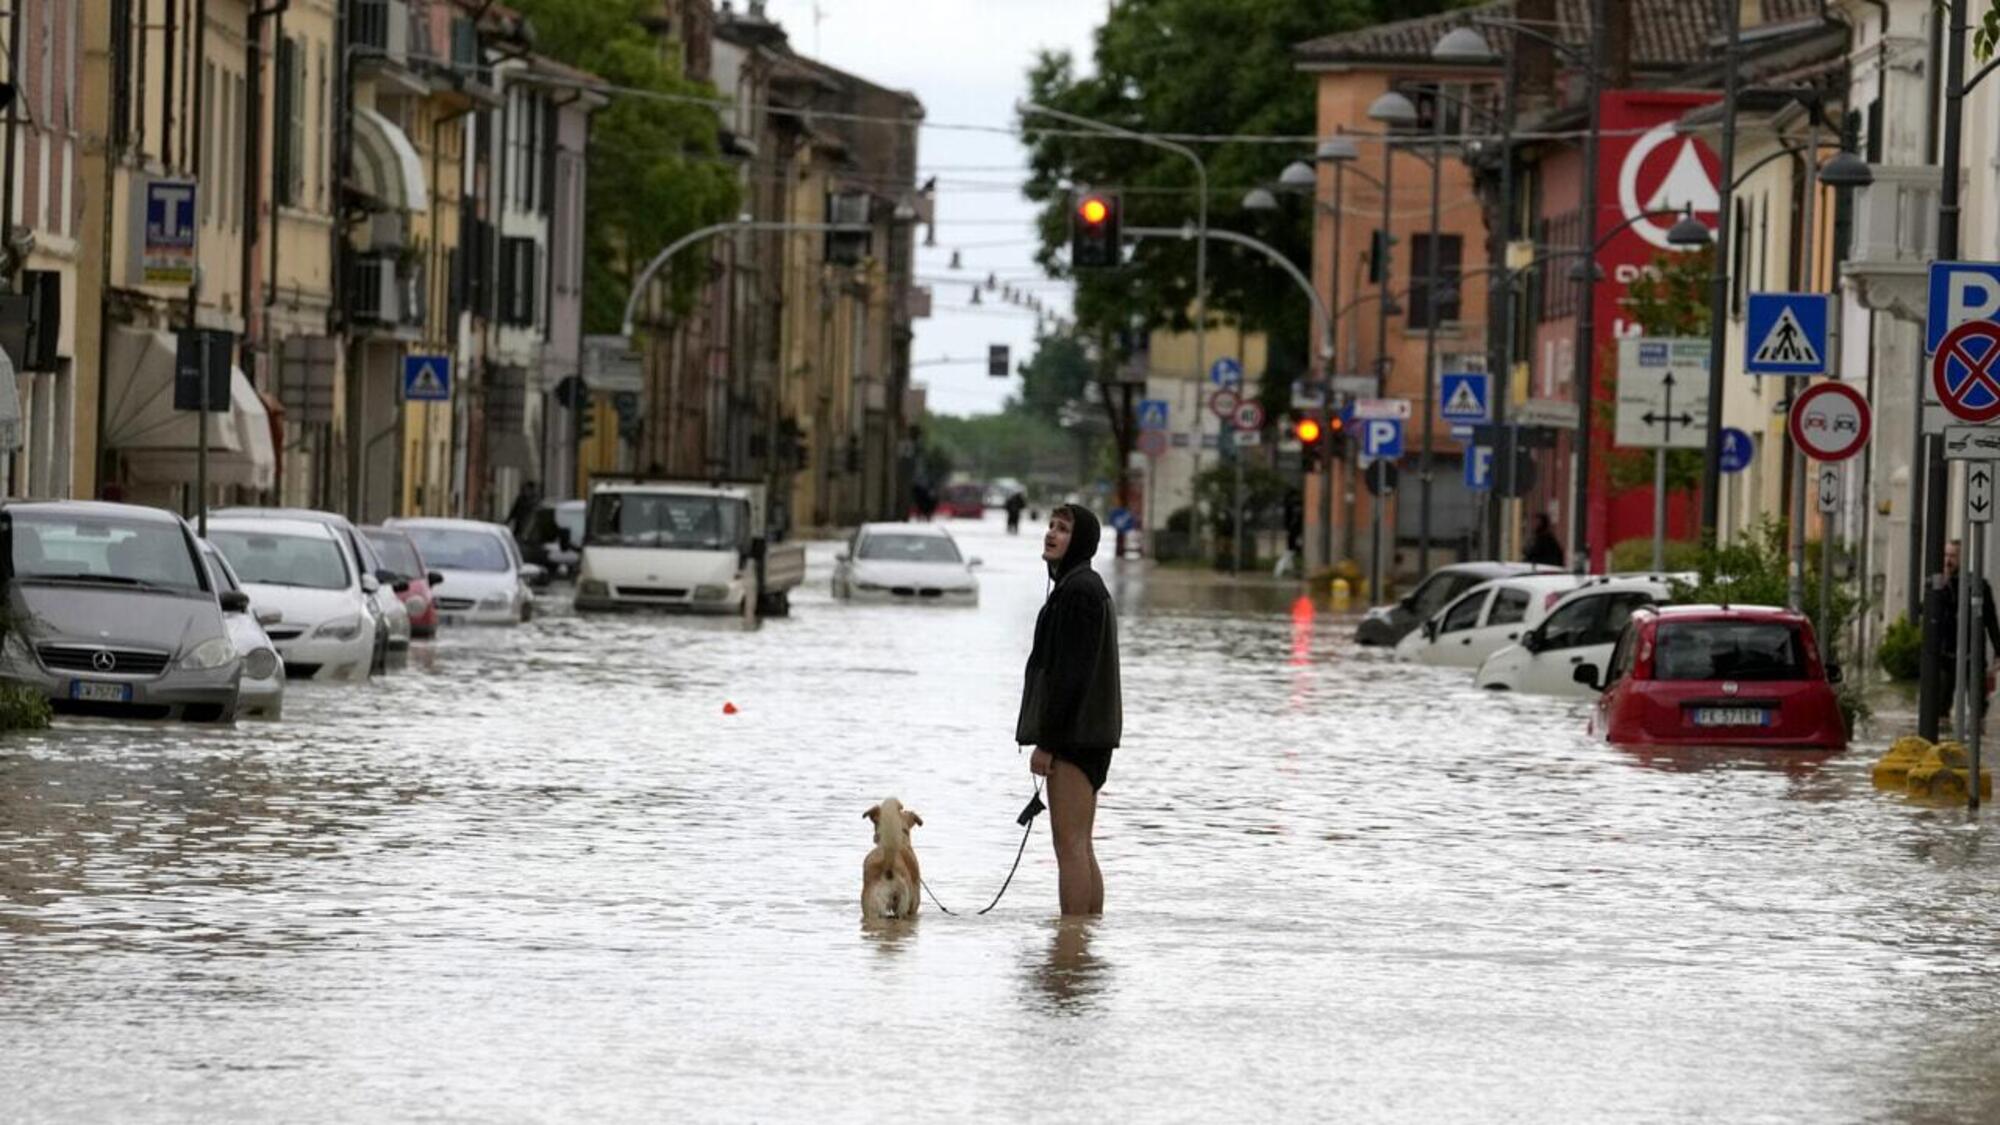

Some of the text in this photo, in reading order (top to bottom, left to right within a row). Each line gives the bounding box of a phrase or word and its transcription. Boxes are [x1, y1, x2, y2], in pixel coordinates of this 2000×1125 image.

[152, 187, 191, 236] T
[1947, 271, 2000, 332] P
[1370, 421, 1395, 453] P
